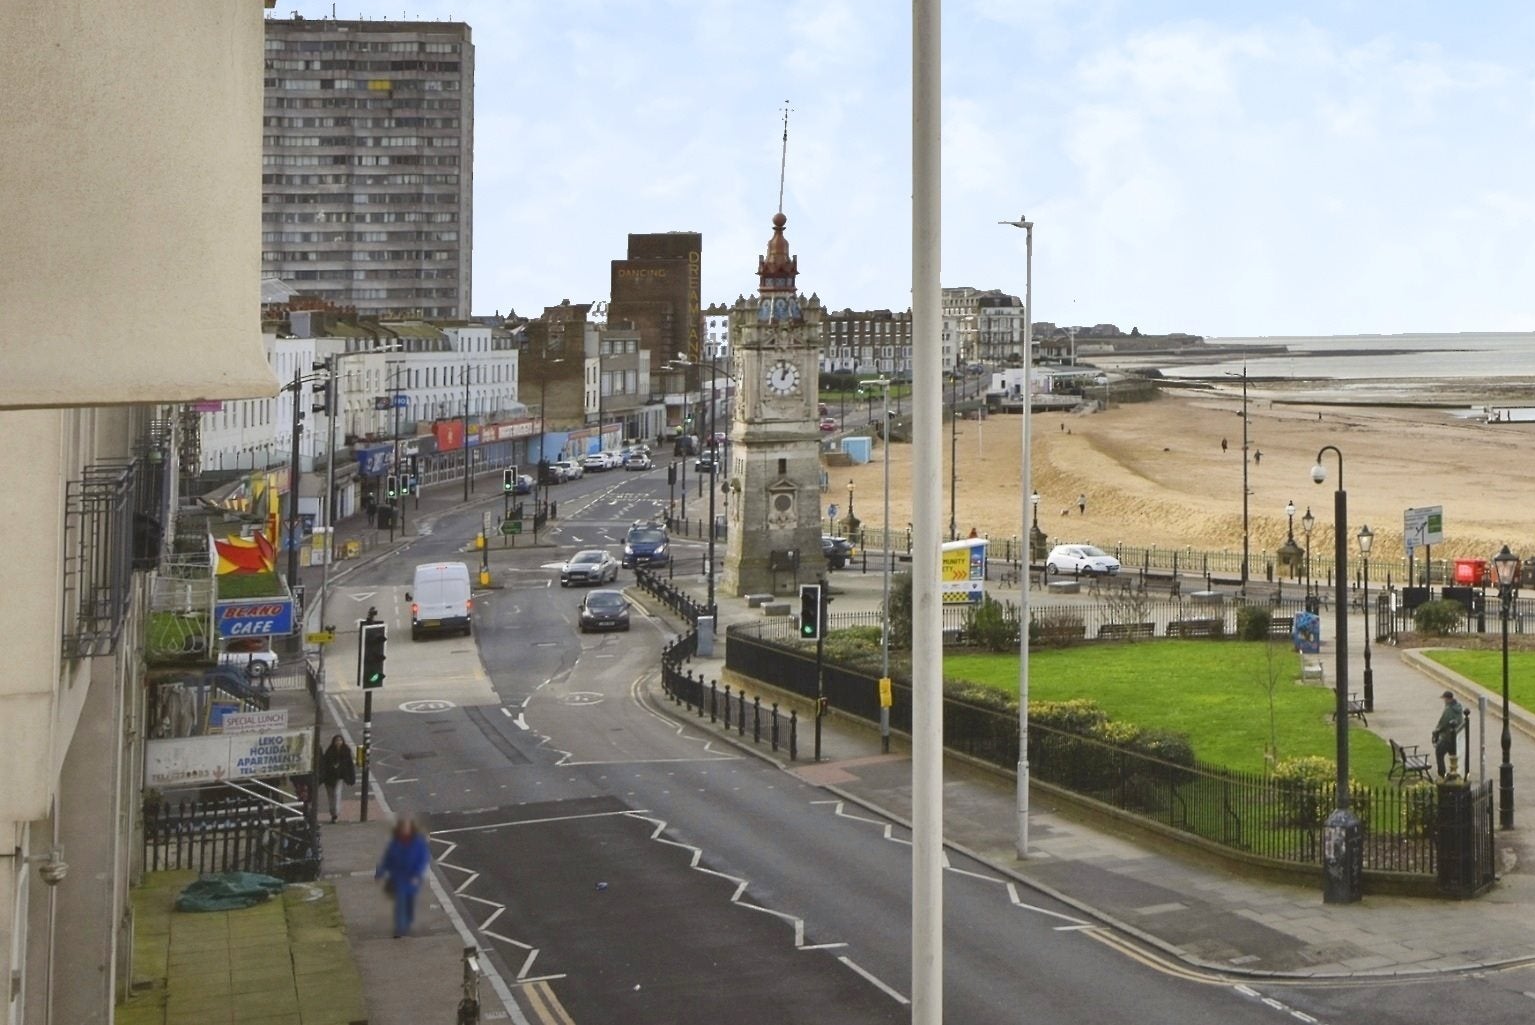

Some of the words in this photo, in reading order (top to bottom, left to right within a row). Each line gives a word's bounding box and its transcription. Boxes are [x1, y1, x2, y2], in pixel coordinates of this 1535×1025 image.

[223, 604, 284, 619] BEANO
[230, 620, 274, 635] CAFE
[226, 716, 256, 726] SPECIAL
[257, 713, 284, 724] LUNCH
[249, 744, 291, 757] HOLIDAY
[236, 753, 302, 767] APARTMENTS
